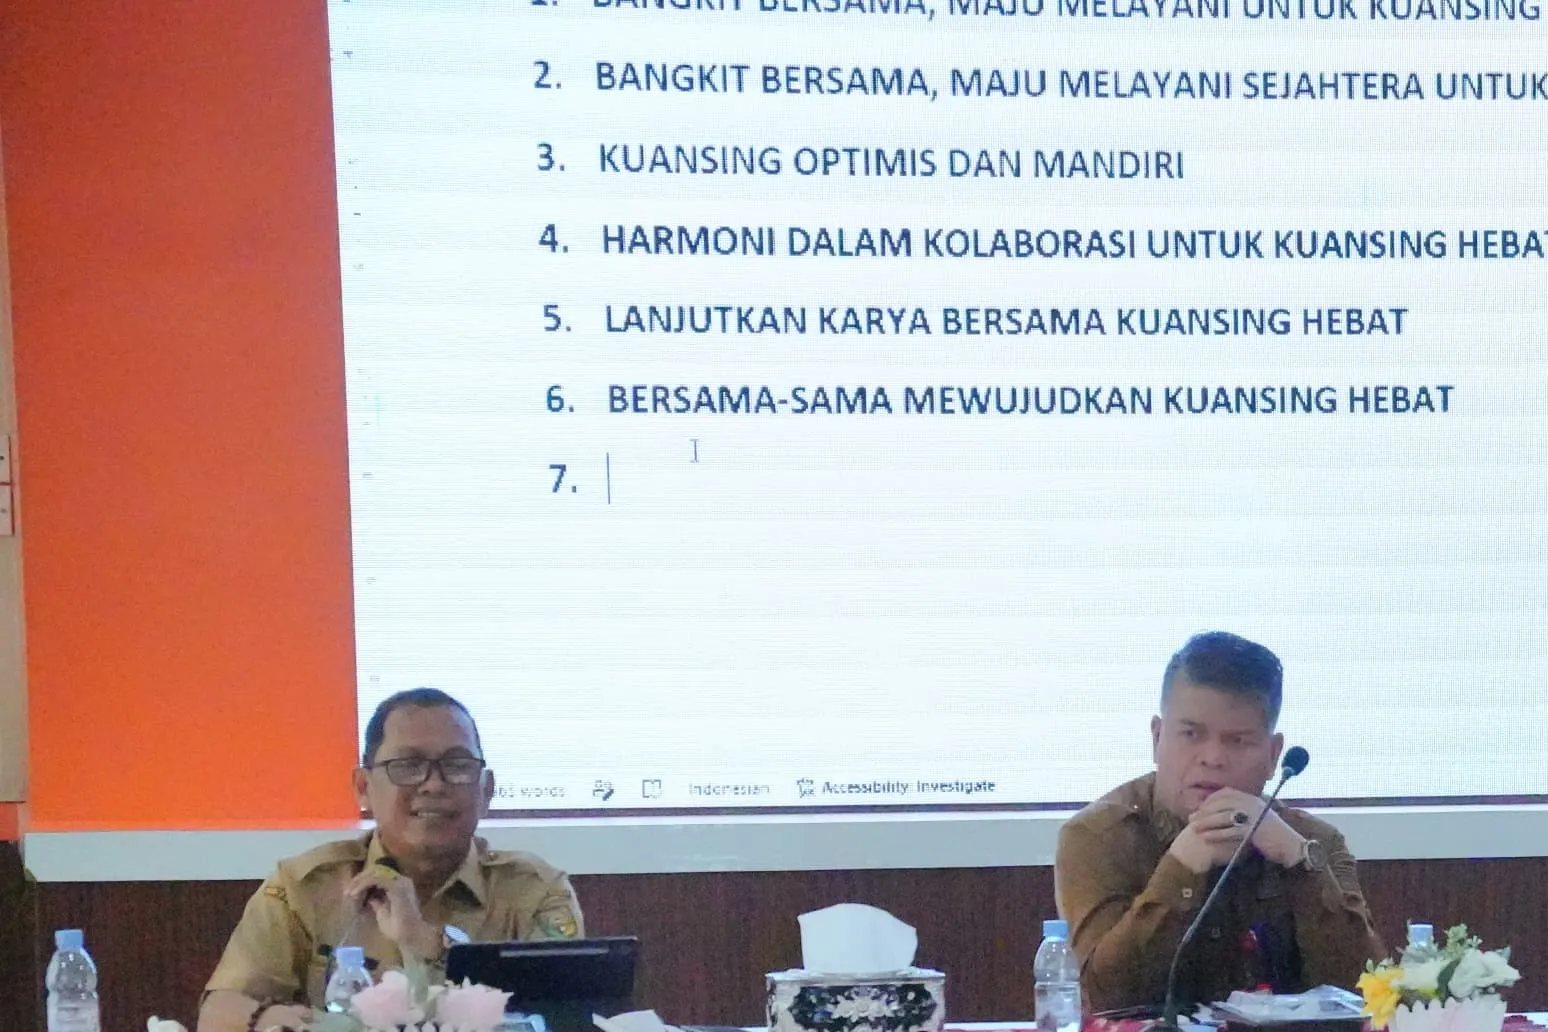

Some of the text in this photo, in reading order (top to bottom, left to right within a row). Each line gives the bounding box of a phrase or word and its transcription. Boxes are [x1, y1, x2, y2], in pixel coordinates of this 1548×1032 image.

[1056, 0, 1231, 20] MELAYANI
[1242, 0, 1359, 20] UNTUK
[1369, 0, 1541, 21] KUANSING
[532, 59, 562, 90] 2.
[595, 60, 751, 94] BANGKIT
[761, 63, 938, 103] BERSAMA,
[949, 67, 1047, 98] MAJU
[1058, 68, 1233, 100] MELAYANI
[1242, 69, 1425, 101] SEJAHTERA
[536, 141, 1184, 180] 3. KUANSING OPTIMIS DAN MANDIRI
[537, 223, 569, 254] 4.
[602, 223, 776, 257] HARMONI
[787, 226, 913, 258] DALAM
[923, 228, 1136, 259] KOLABORASI
[1147, 229, 1265, 260] UNTUK
[1274, 229, 1447, 260] KUANSING
[543, 303, 1410, 336] 5. LANJUTKAN KARYA BERSAMA KUANSING HEBAT
[545, 383, 1456, 415] 6. BERSAMA-SAMA MEWUJUDKAN KUANSING HEBAT
[548, 463, 577, 494] 7.
[916, 779, 997, 794] Investigate
